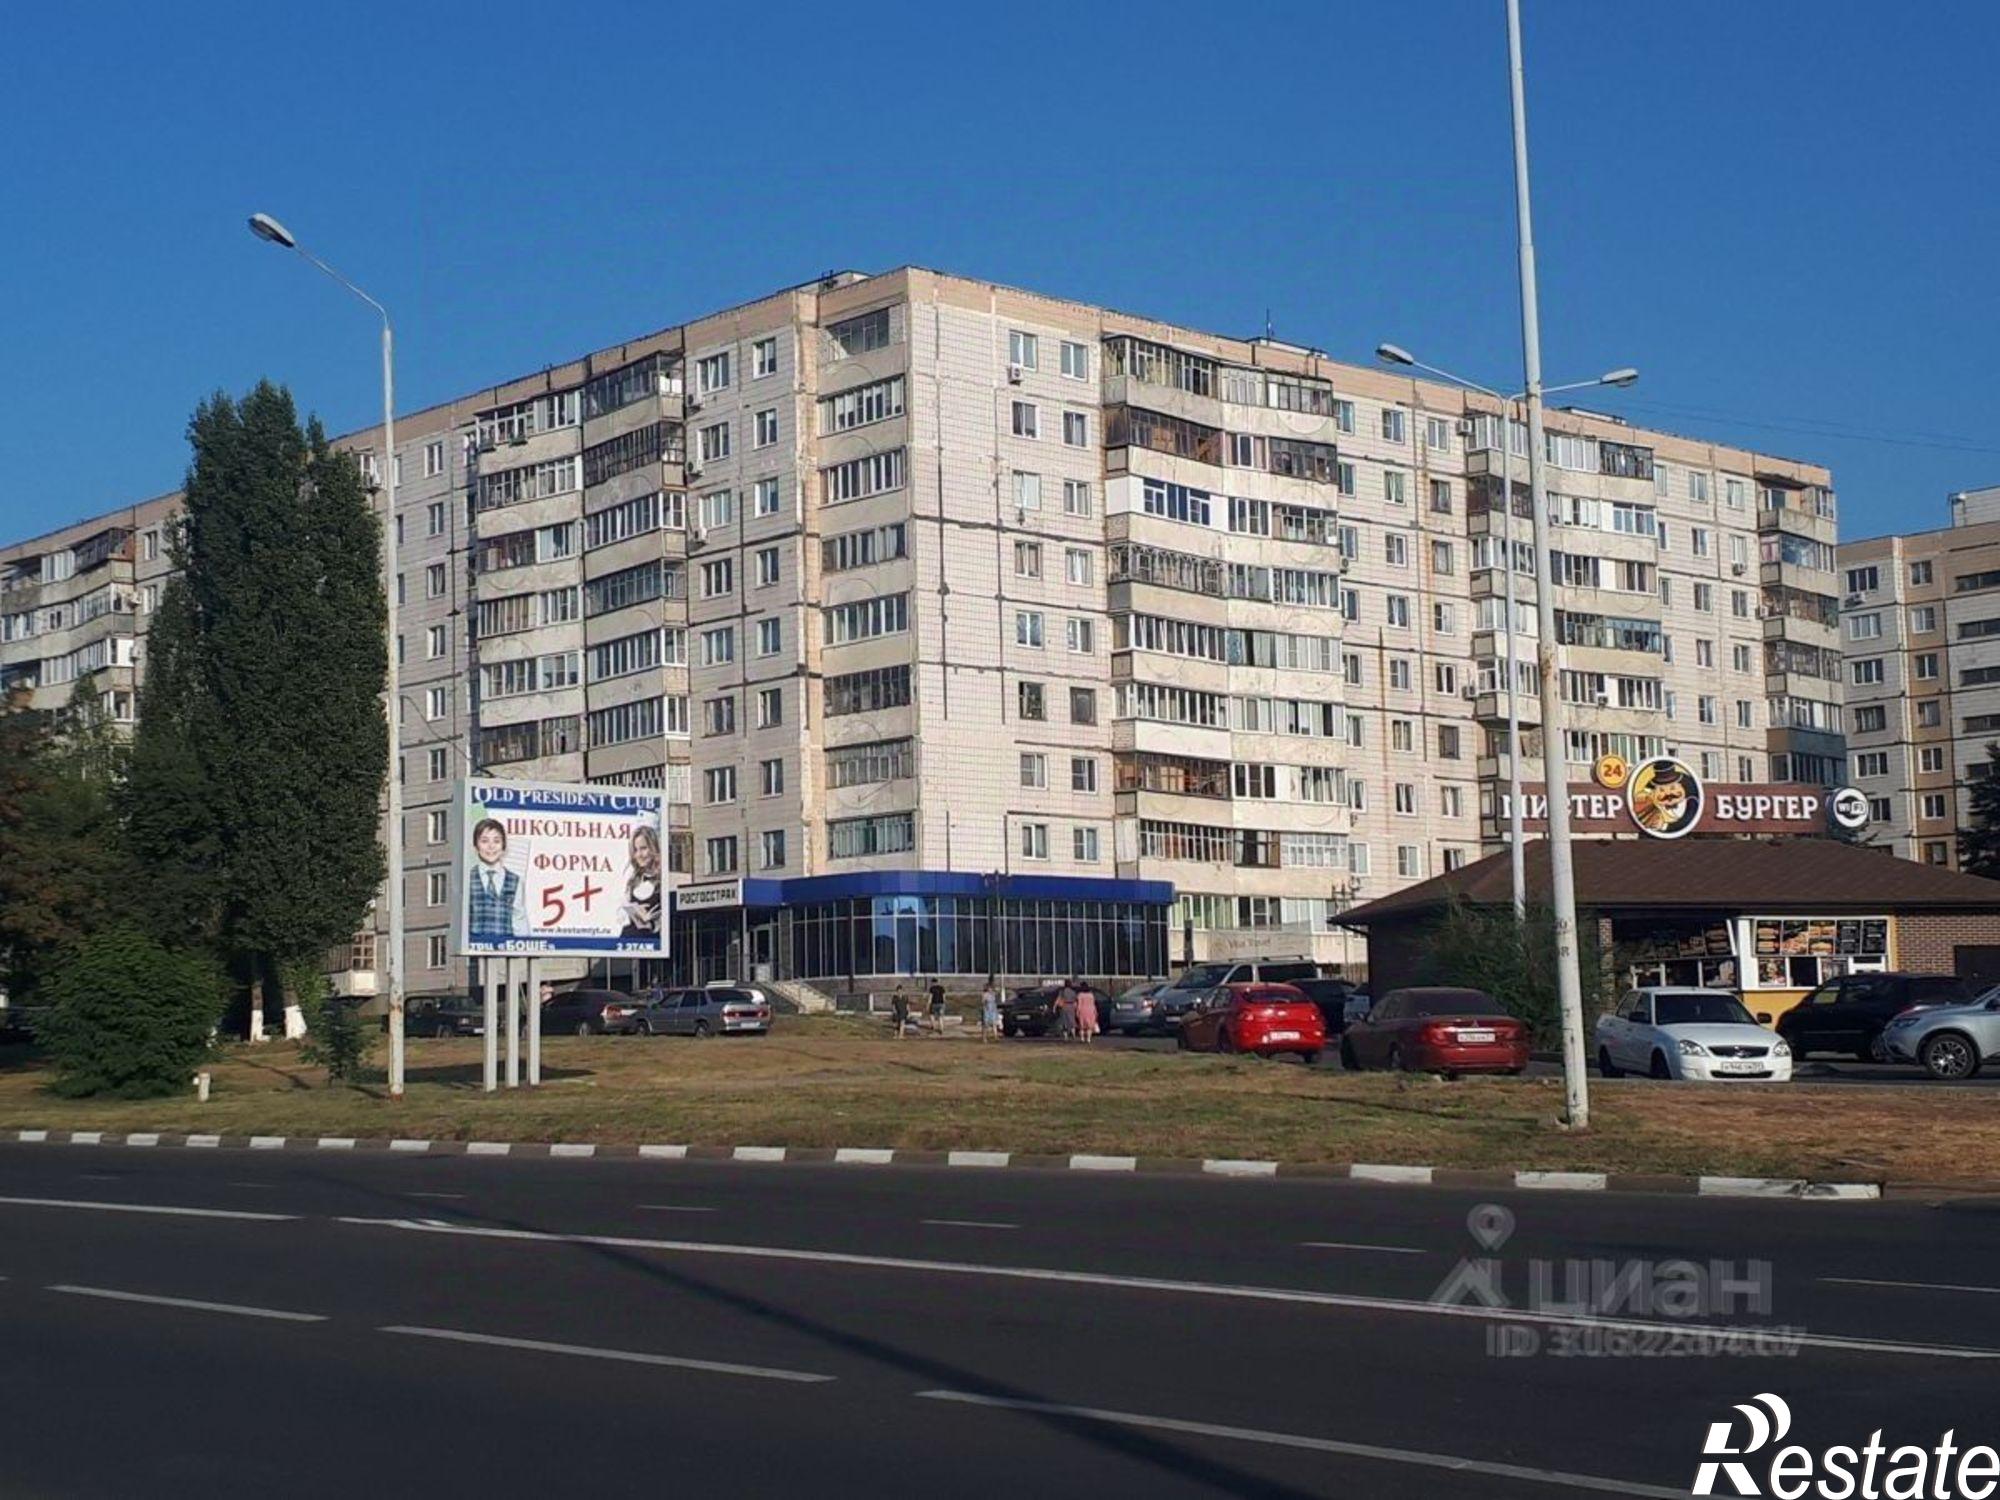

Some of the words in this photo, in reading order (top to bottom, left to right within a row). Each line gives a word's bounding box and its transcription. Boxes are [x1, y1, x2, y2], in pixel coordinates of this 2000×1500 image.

[1603, 763, 1622, 778] 24
[474, 787, 514, 803] OLD
[519, 790, 604, 806] PRESIDENT
[610, 795, 655, 810] CLUB
[1502, 795, 1622, 819] МИТЕР
[1716, 795, 1818, 819] БУРГЕР
[506, 818, 631, 839] ШКОЛЬНАЯ
[534, 853, 613, 872] ФОРМА
[542, 875, 603, 926] 5+
